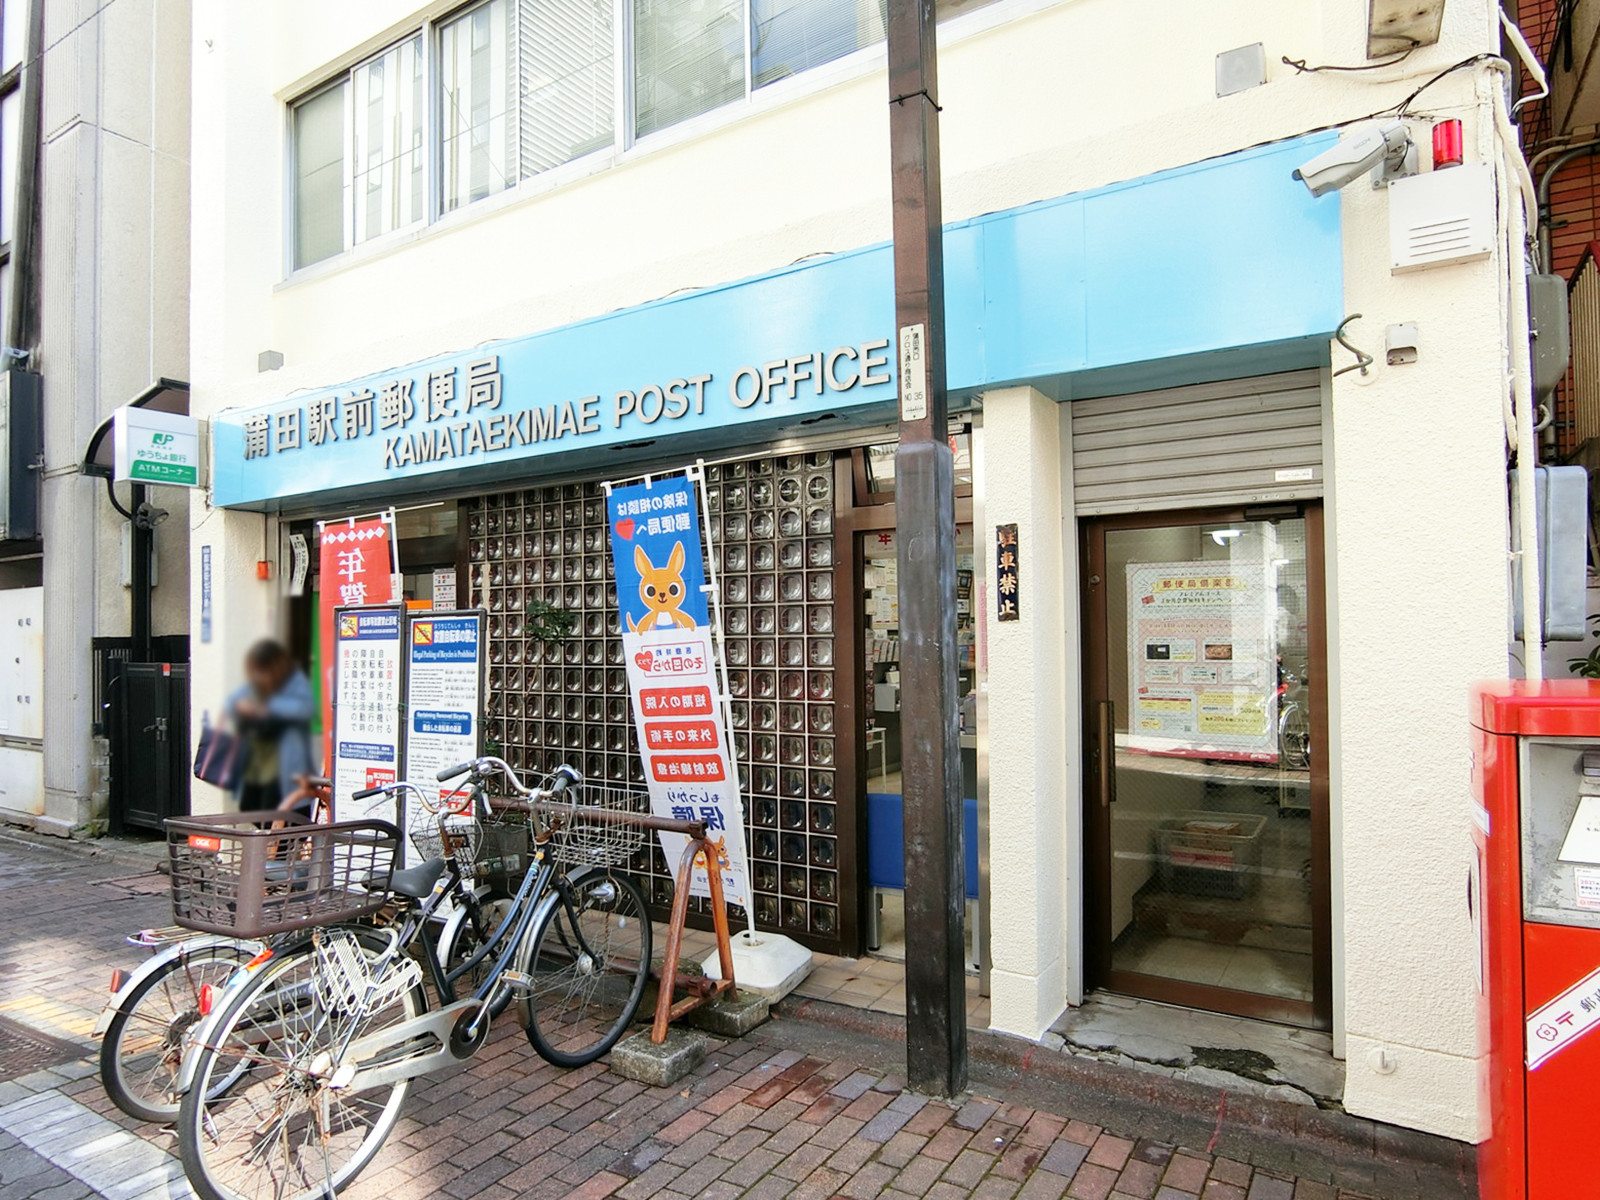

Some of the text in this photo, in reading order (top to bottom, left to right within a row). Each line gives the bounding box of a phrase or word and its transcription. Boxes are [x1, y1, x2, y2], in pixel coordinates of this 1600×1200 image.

[243, 355, 502, 460] 蒲田駅前郵便局
[382, 338, 890, 469] KAMATAEKIMAE POST OFFICE
[913, 392, 923, 401] 35
[137, 450, 187, 463] ゆうちょ銀行
[152, 433, 174, 445] JP
[998, 531, 1017, 615] 駐車禁止
